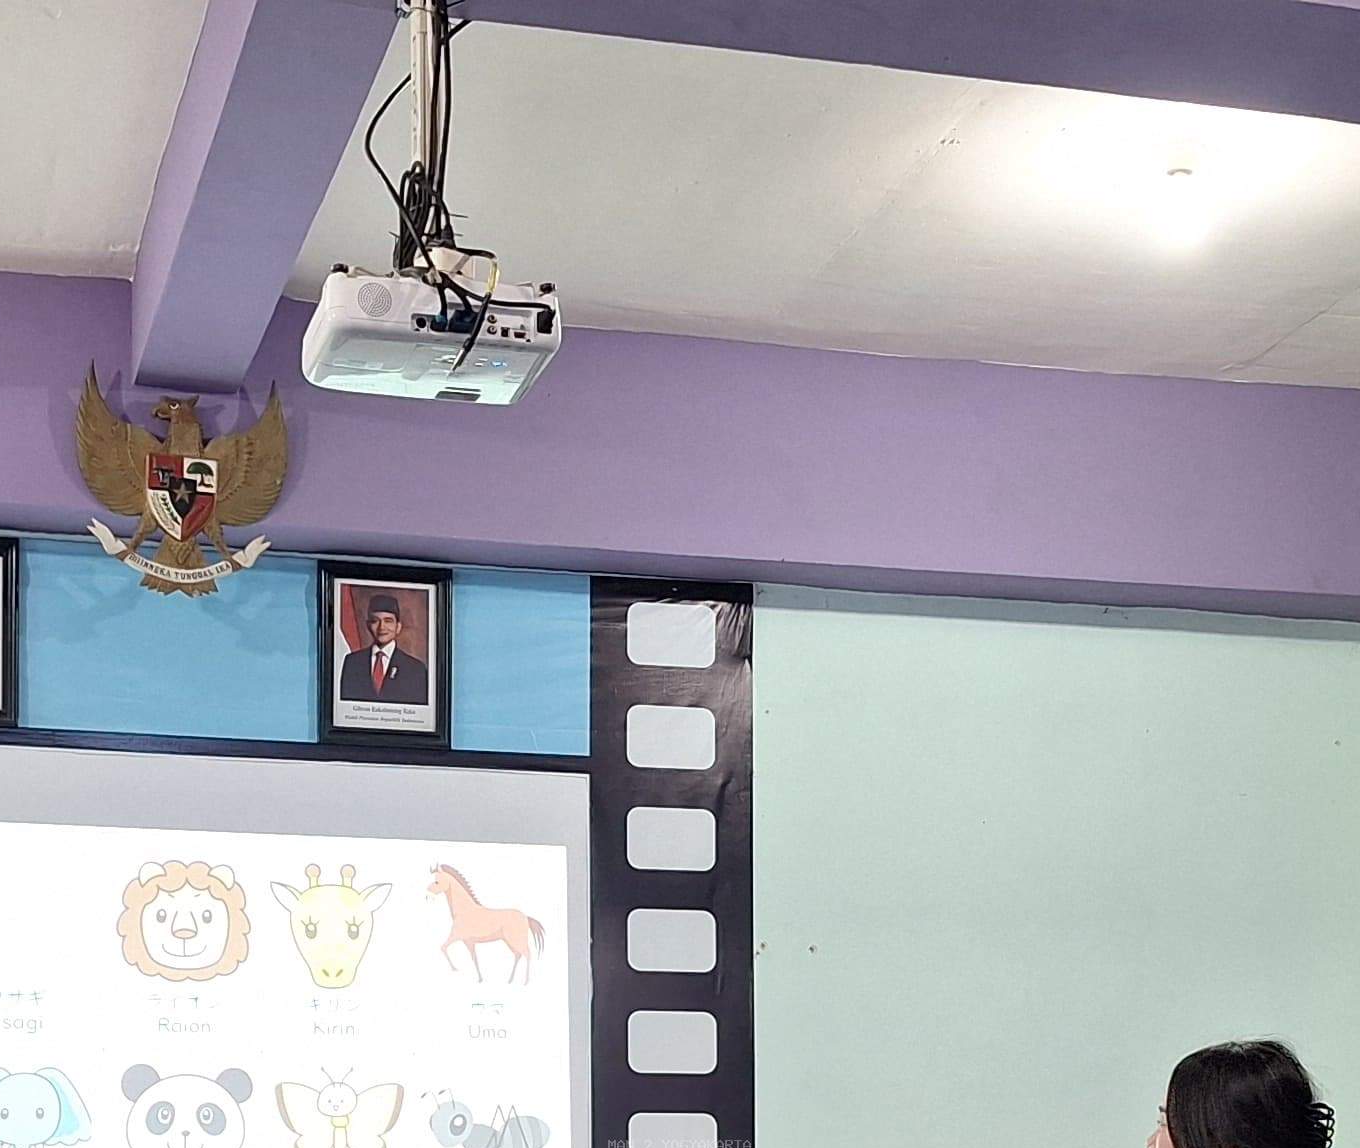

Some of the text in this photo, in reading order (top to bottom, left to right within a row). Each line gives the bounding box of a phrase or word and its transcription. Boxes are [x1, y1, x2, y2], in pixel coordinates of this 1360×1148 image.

[157, 1016, 211, 1034] Raion
[312, 1020, 355, 1036] Kirin
[468, 1024, 508, 1040] Uma
